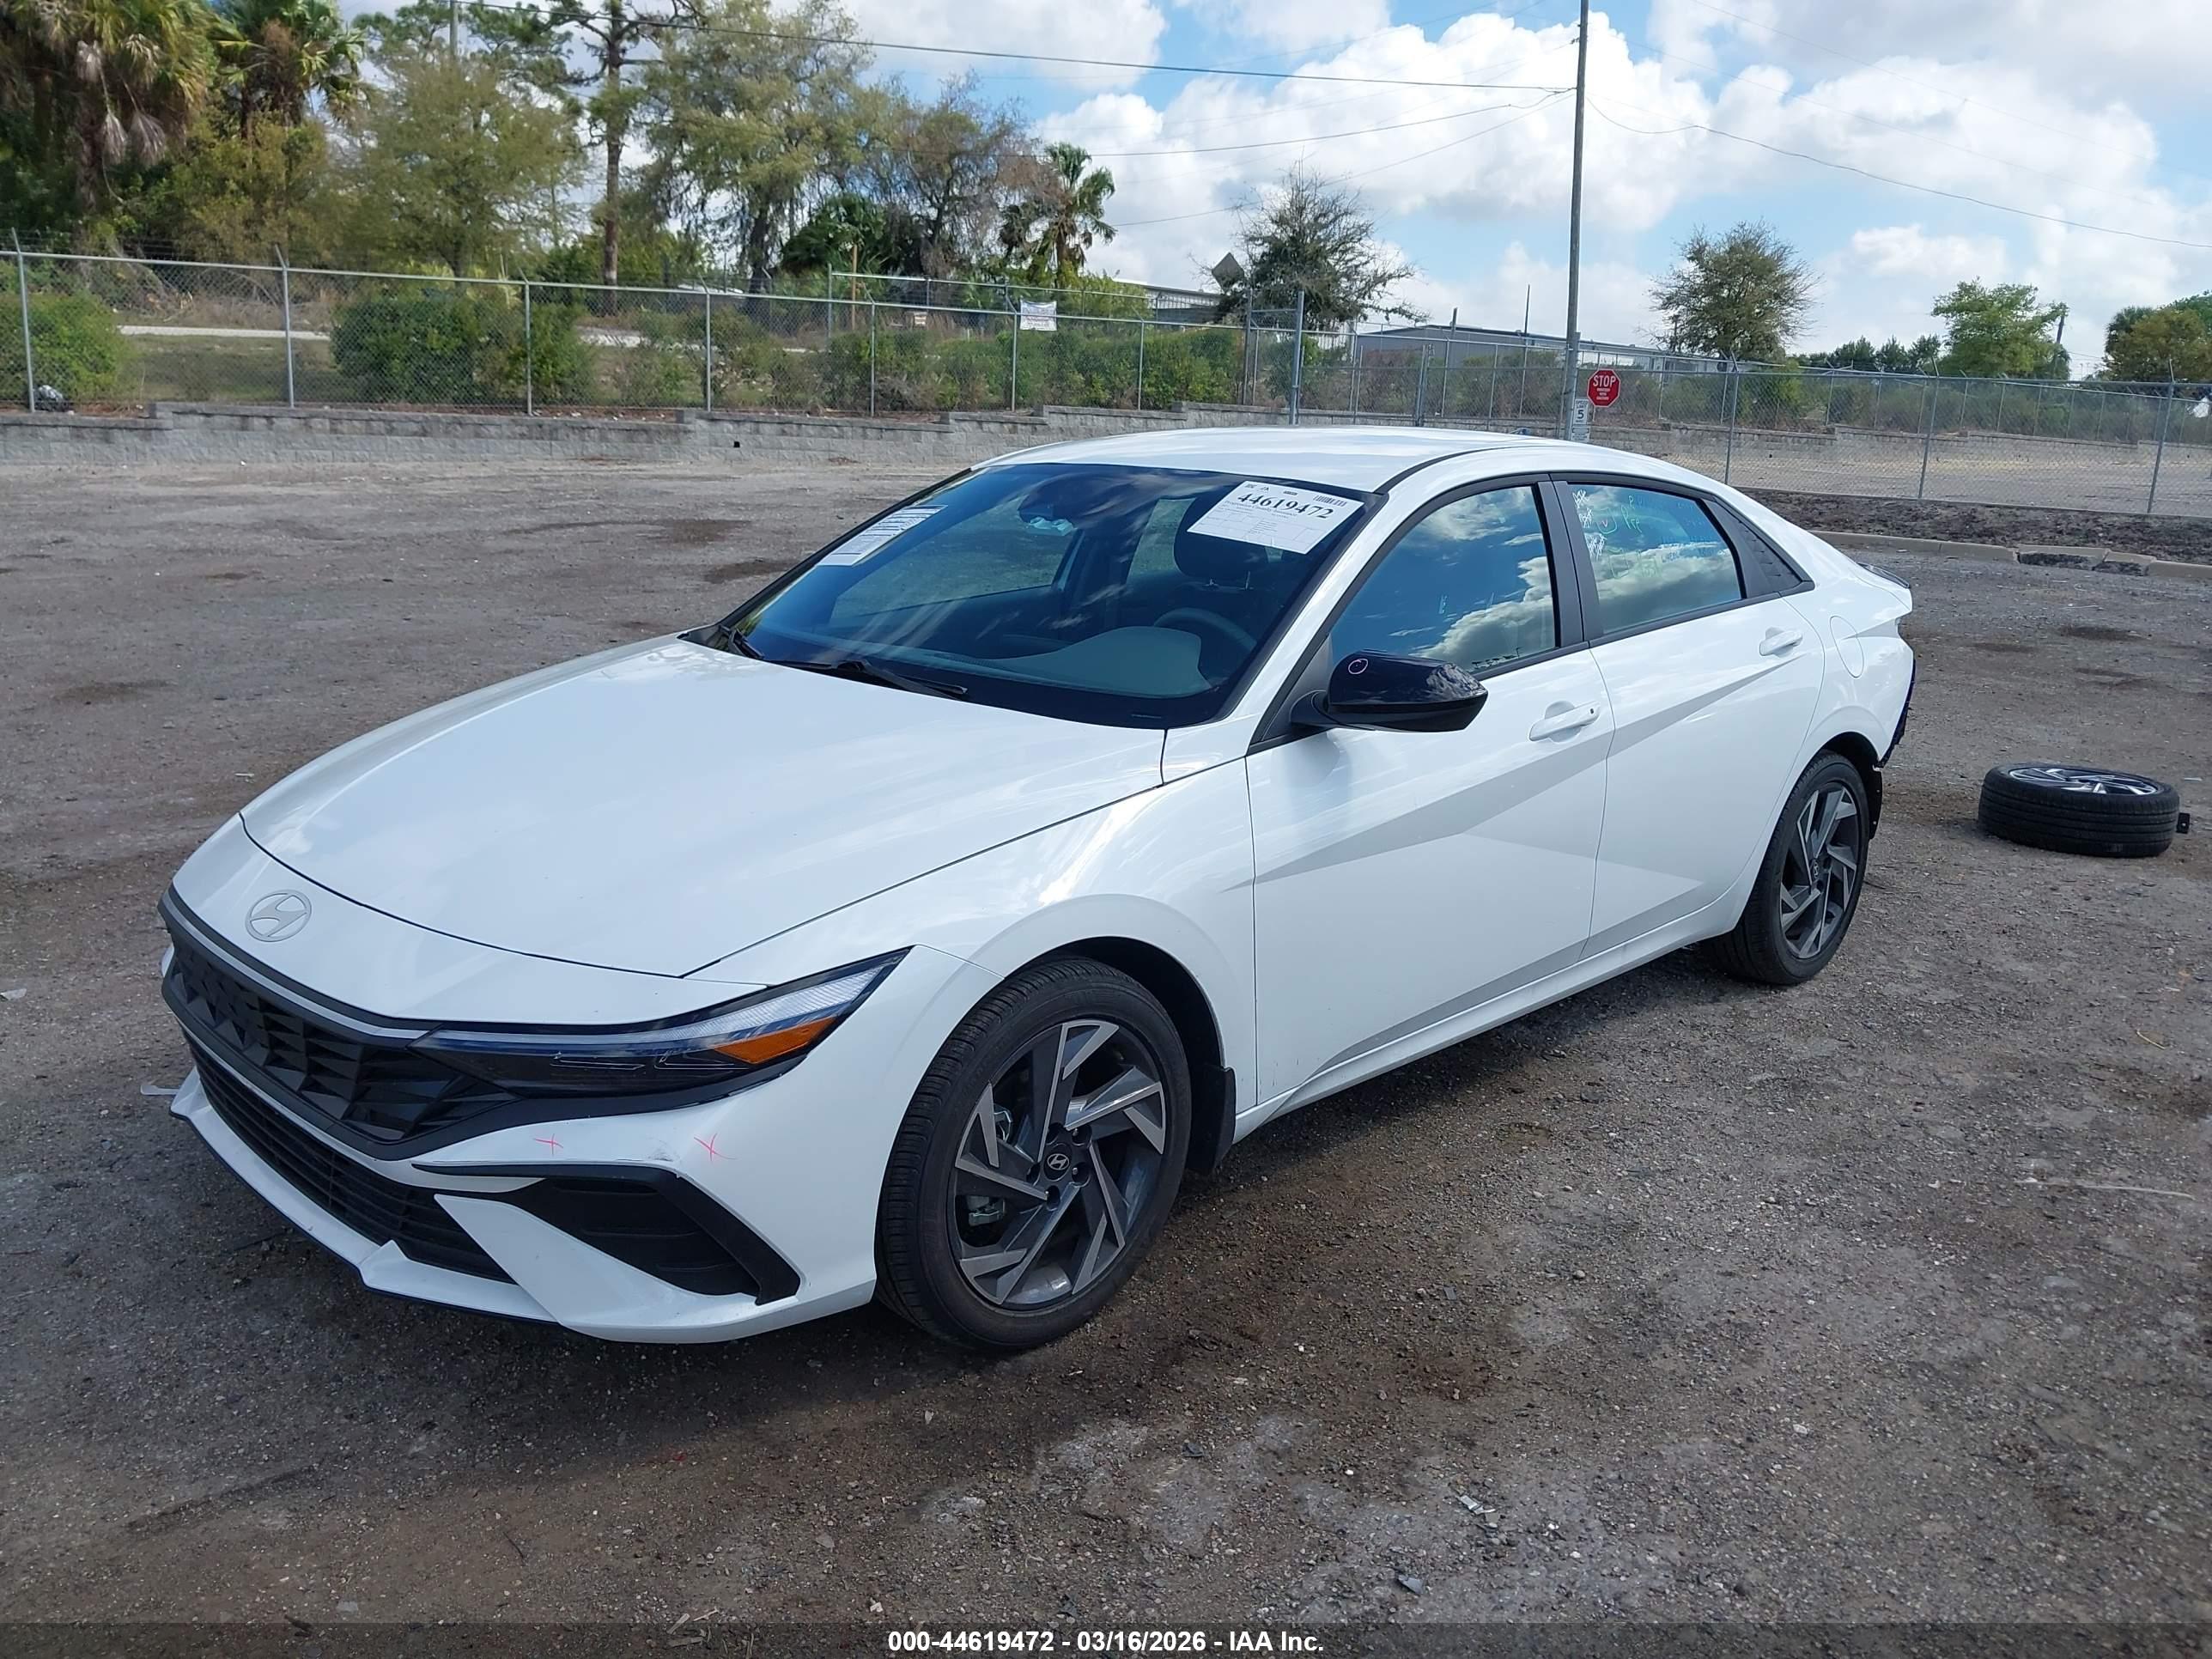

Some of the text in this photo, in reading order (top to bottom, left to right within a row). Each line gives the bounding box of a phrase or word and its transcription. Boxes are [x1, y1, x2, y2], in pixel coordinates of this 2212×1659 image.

[1593, 374, 1616, 387] STOP
[1577, 410, 1584, 419] 5
[1237, 493, 1334, 520] 44619472
